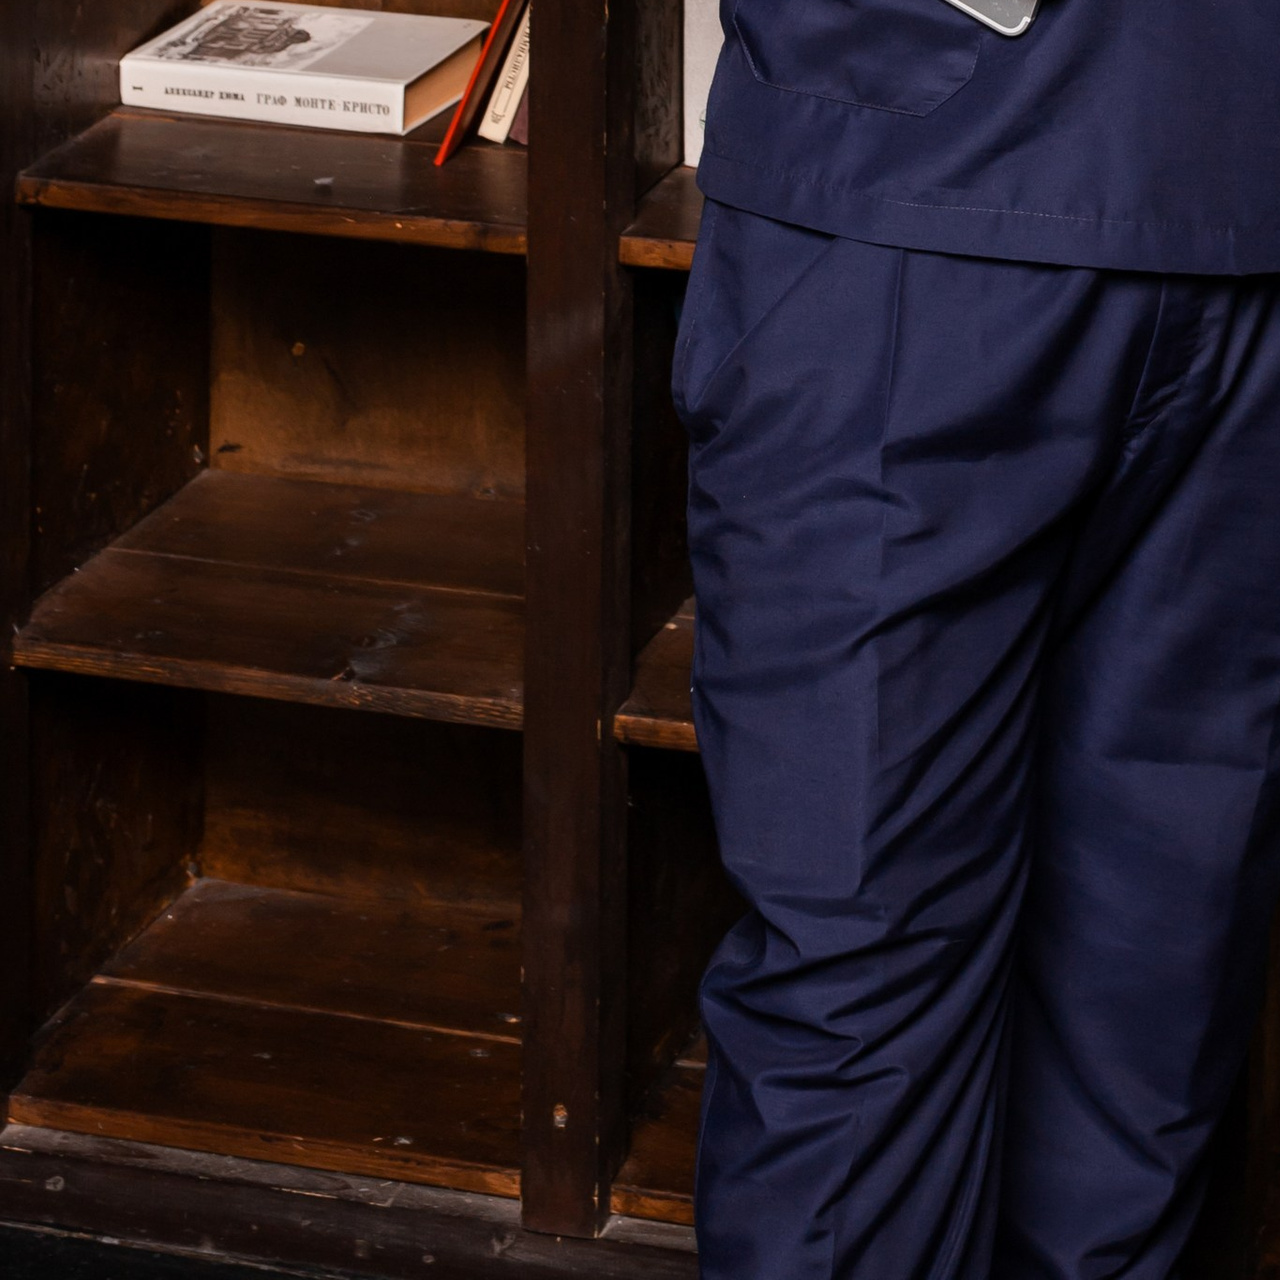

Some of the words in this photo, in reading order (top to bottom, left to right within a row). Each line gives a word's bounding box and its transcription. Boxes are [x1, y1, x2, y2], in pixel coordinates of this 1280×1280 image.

[162, 84, 215, 101] АЛЕКСАНДР
[217, 89, 246, 103] ДЮМА
[254, 90, 288, 108] ГРАФ
[291, 94, 390, 120] МОНТЕ-КРИСТО
